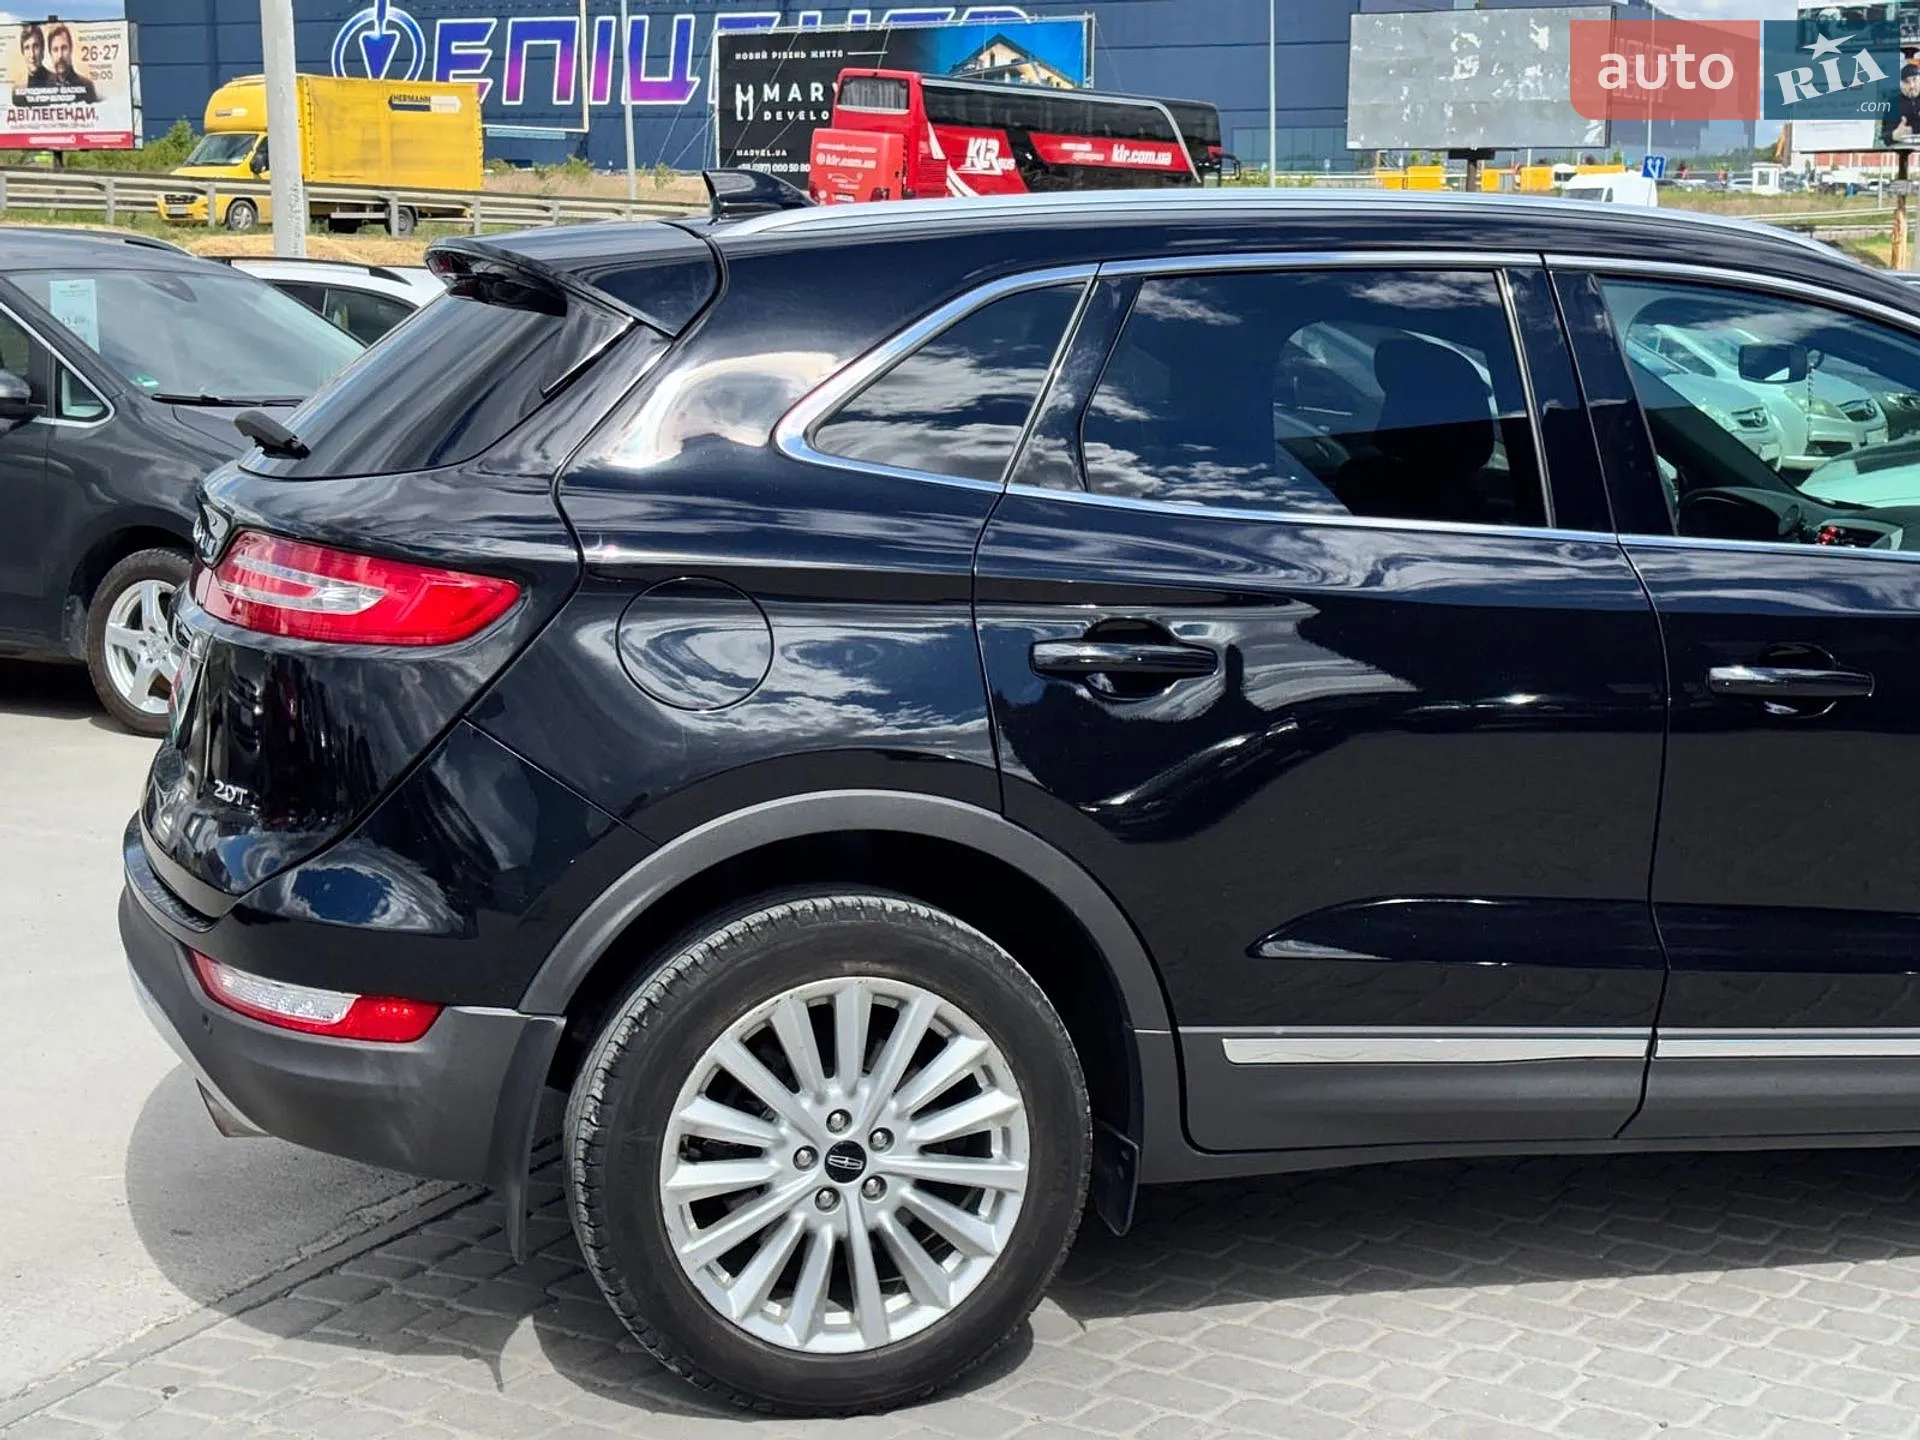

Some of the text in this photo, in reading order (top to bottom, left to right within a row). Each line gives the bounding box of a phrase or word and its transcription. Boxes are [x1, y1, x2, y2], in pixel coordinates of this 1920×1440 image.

[735, 49, 843, 60] НОВИЙ РІВЕНЬ ЖИТТЯ
[7, 108, 29, 123] ДВІ
[736, 149, 787, 157] MARVEL.UA
[1112, 143, 1173, 166] klr.com.ua
